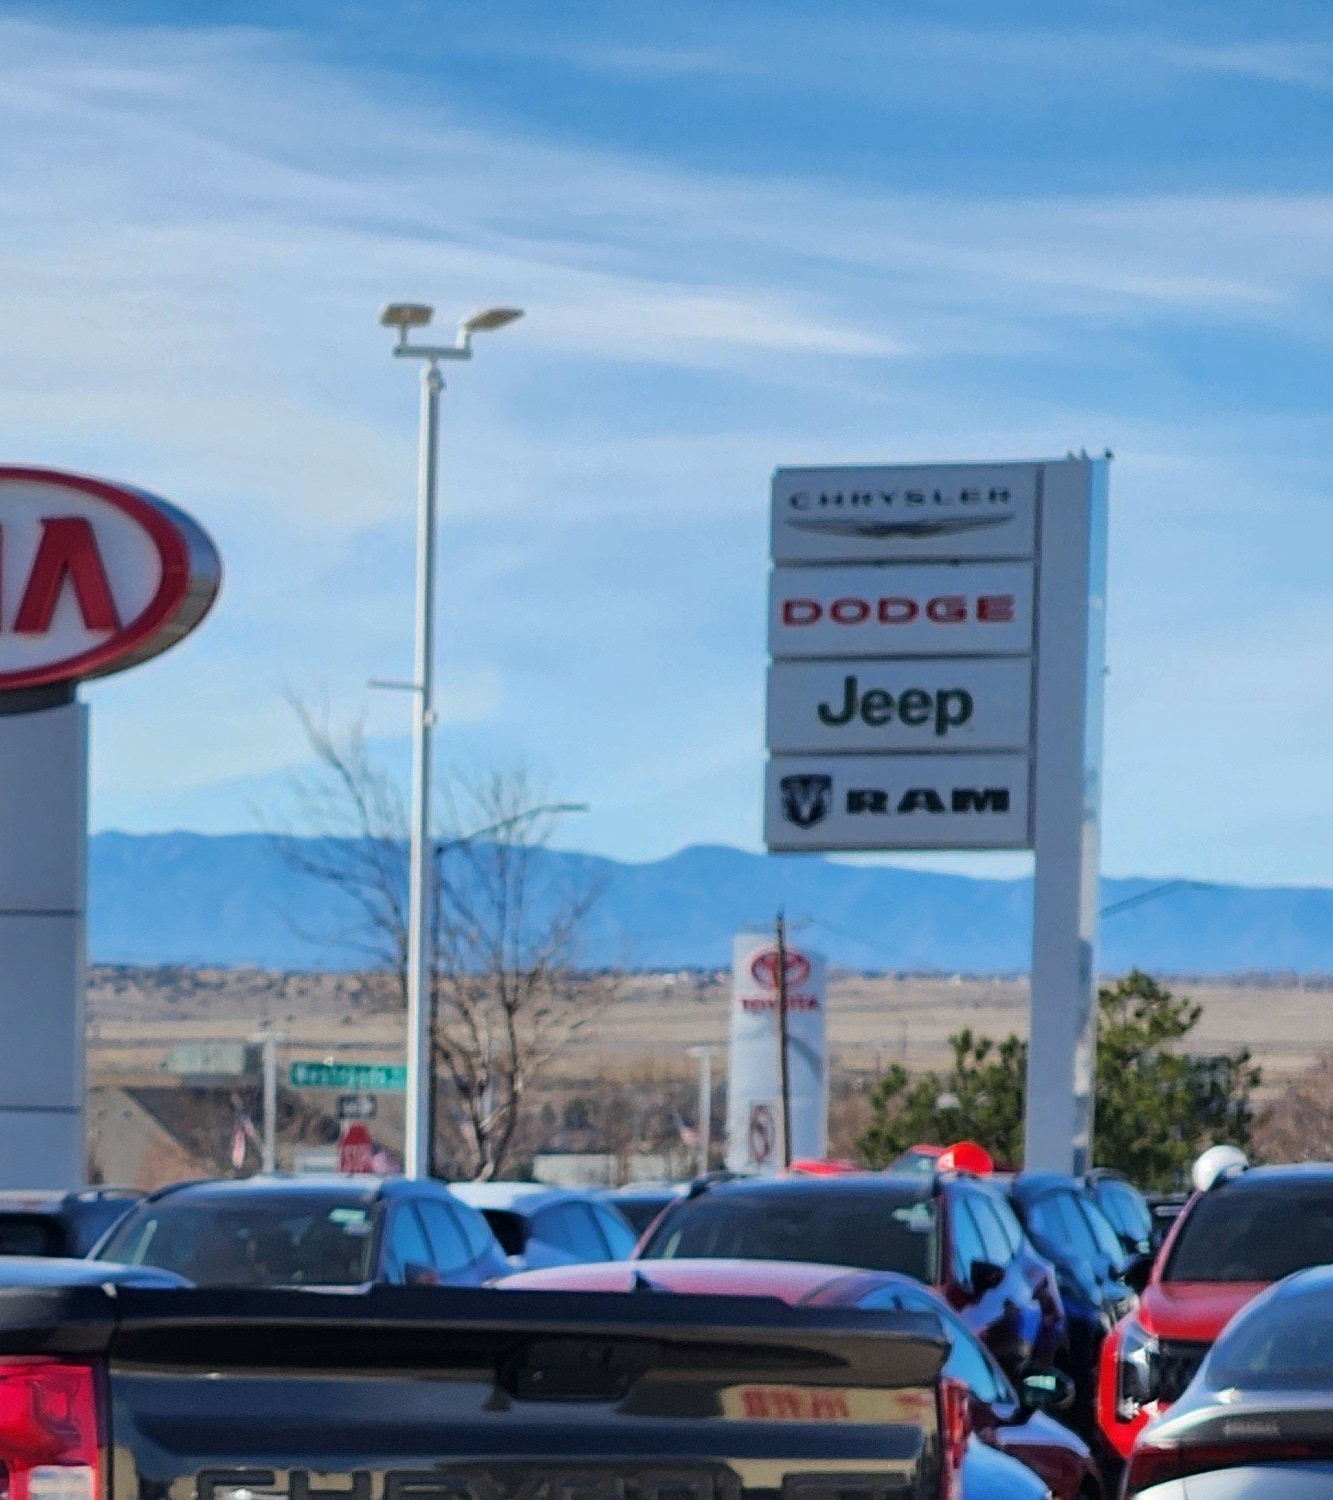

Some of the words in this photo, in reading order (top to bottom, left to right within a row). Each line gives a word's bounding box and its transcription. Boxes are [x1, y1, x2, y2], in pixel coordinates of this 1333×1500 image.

[787, 487, 1013, 510] CHRYSLER
[782, 595, 1016, 627] DODGE
[817, 675, 974, 737] Jeep
[845, 788, 1011, 815] RAM
